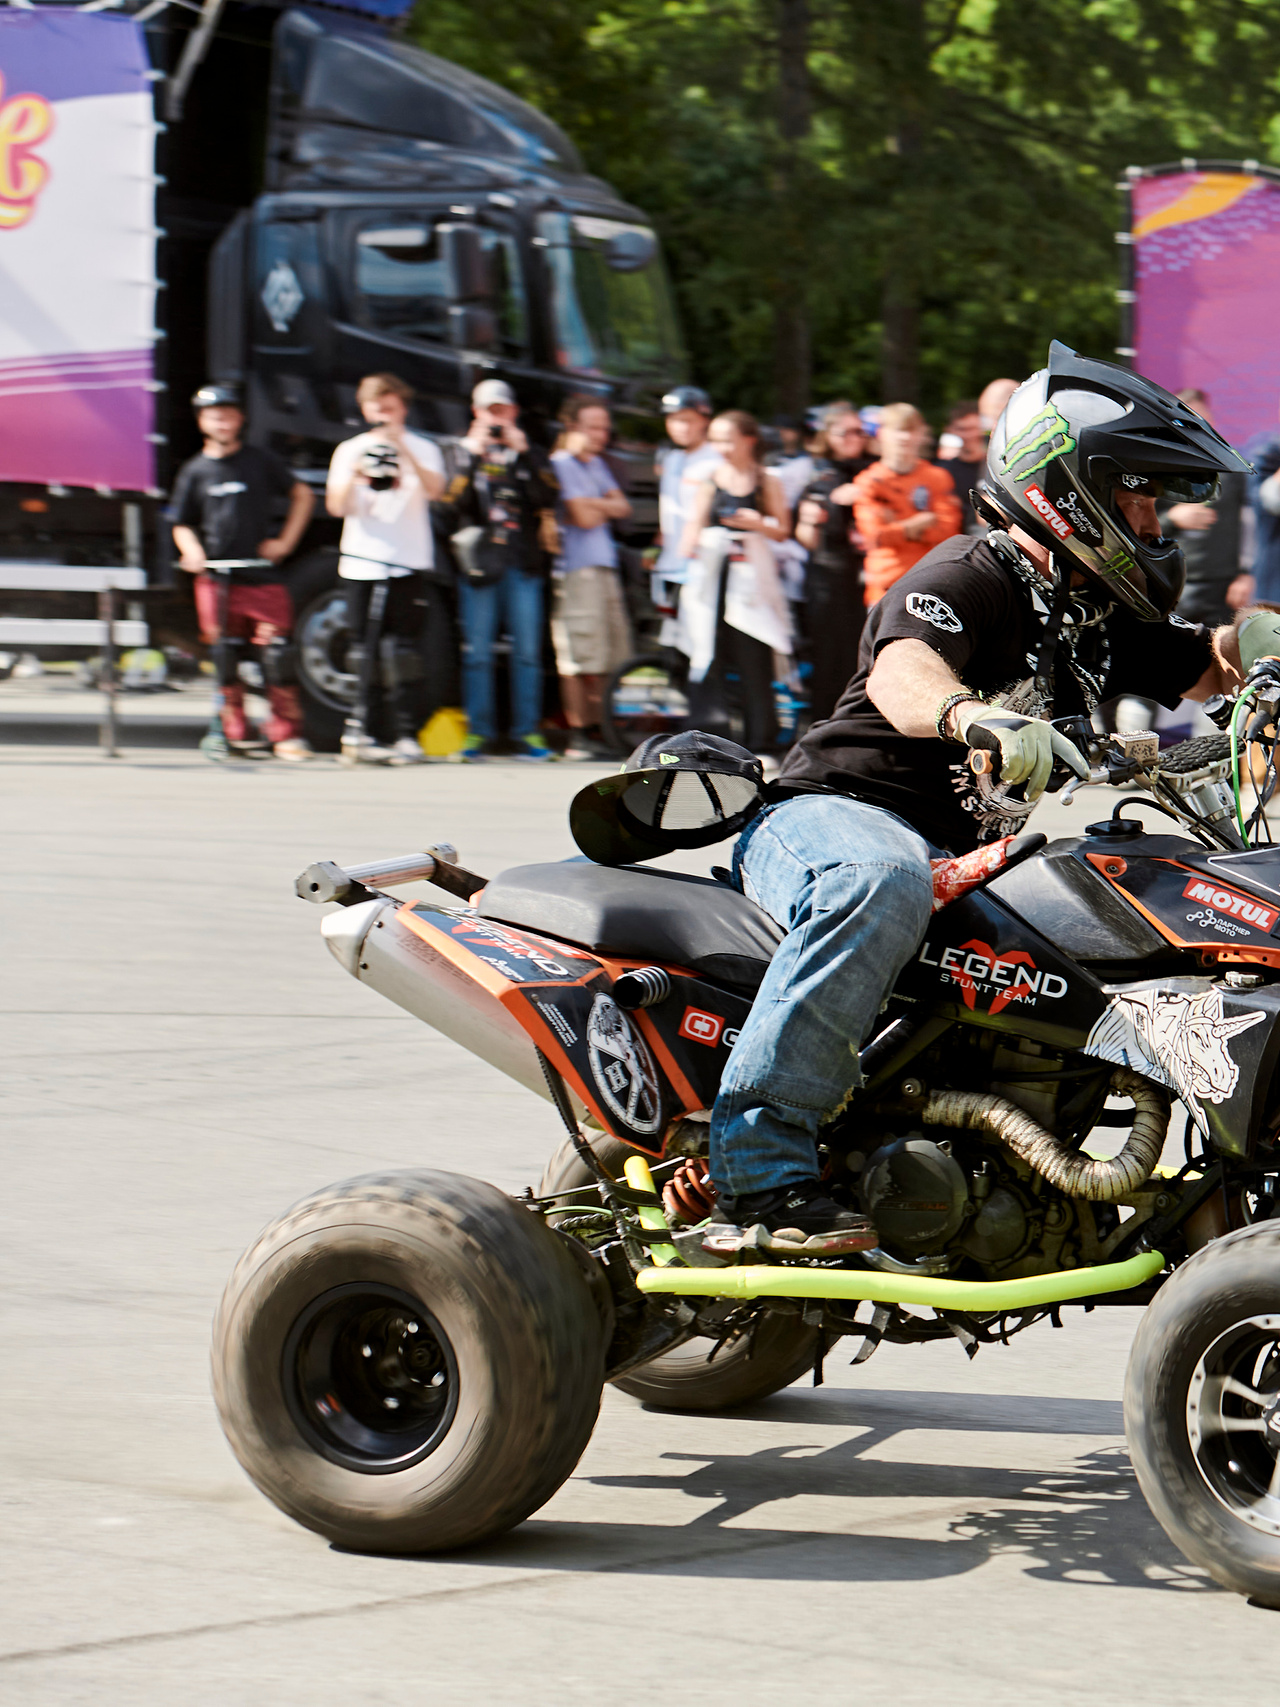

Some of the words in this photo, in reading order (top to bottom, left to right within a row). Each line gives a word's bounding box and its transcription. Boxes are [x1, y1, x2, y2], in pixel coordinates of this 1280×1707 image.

[1026, 489, 1071, 537] MOTUL
[1068, 512, 1088, 533] МОТО
[1187, 882, 1271, 928] MOTUL
[1214, 924, 1236, 937] МОТО
[1216, 919, 1250, 937] ПАРТНЕР
[918, 942, 1068, 998] LEGEND
[940, 973, 993, 993] STUNT
[994, 986, 1037, 1006] TEAM
